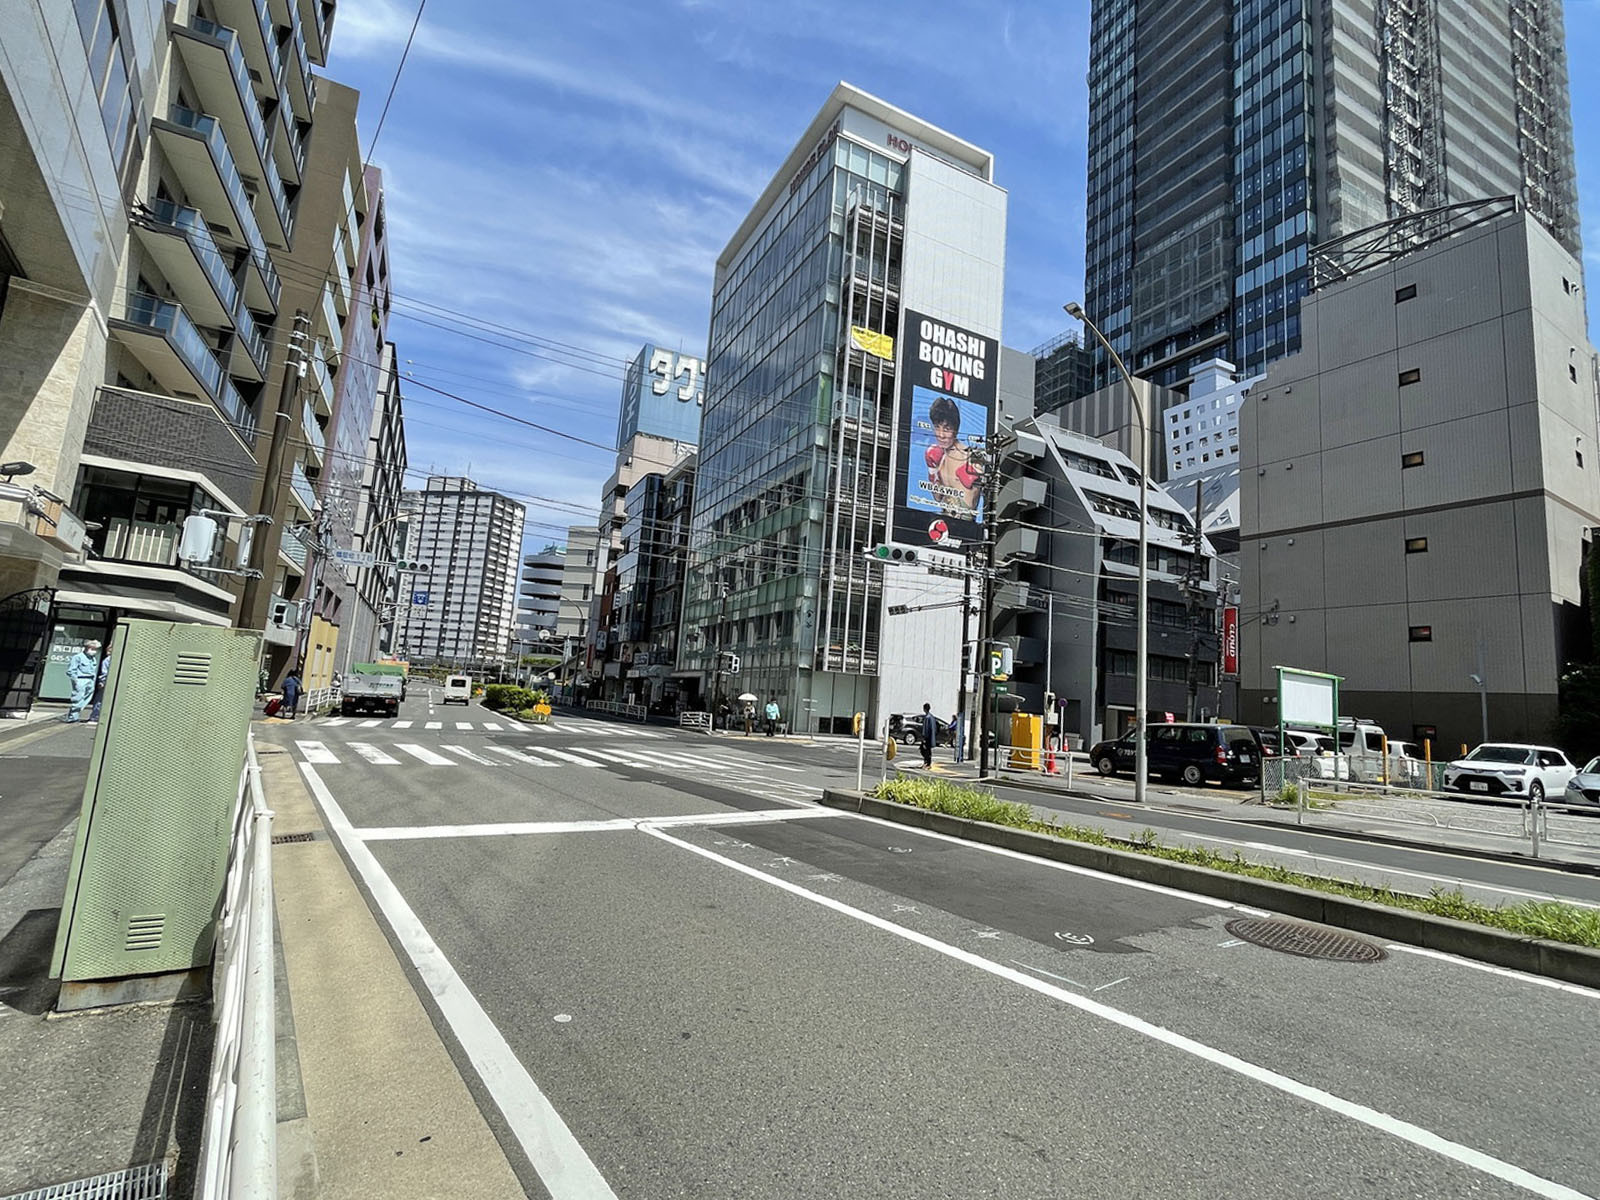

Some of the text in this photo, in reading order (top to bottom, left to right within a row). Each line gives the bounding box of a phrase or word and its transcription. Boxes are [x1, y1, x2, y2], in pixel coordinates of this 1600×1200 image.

[920, 320, 986, 360] OHASHI
[919, 341, 985, 380] BOXING
[930, 367, 970, 397] GYM
[919, 480, 965, 497] WBA&WBC
[992, 657, 1002, 675] P
